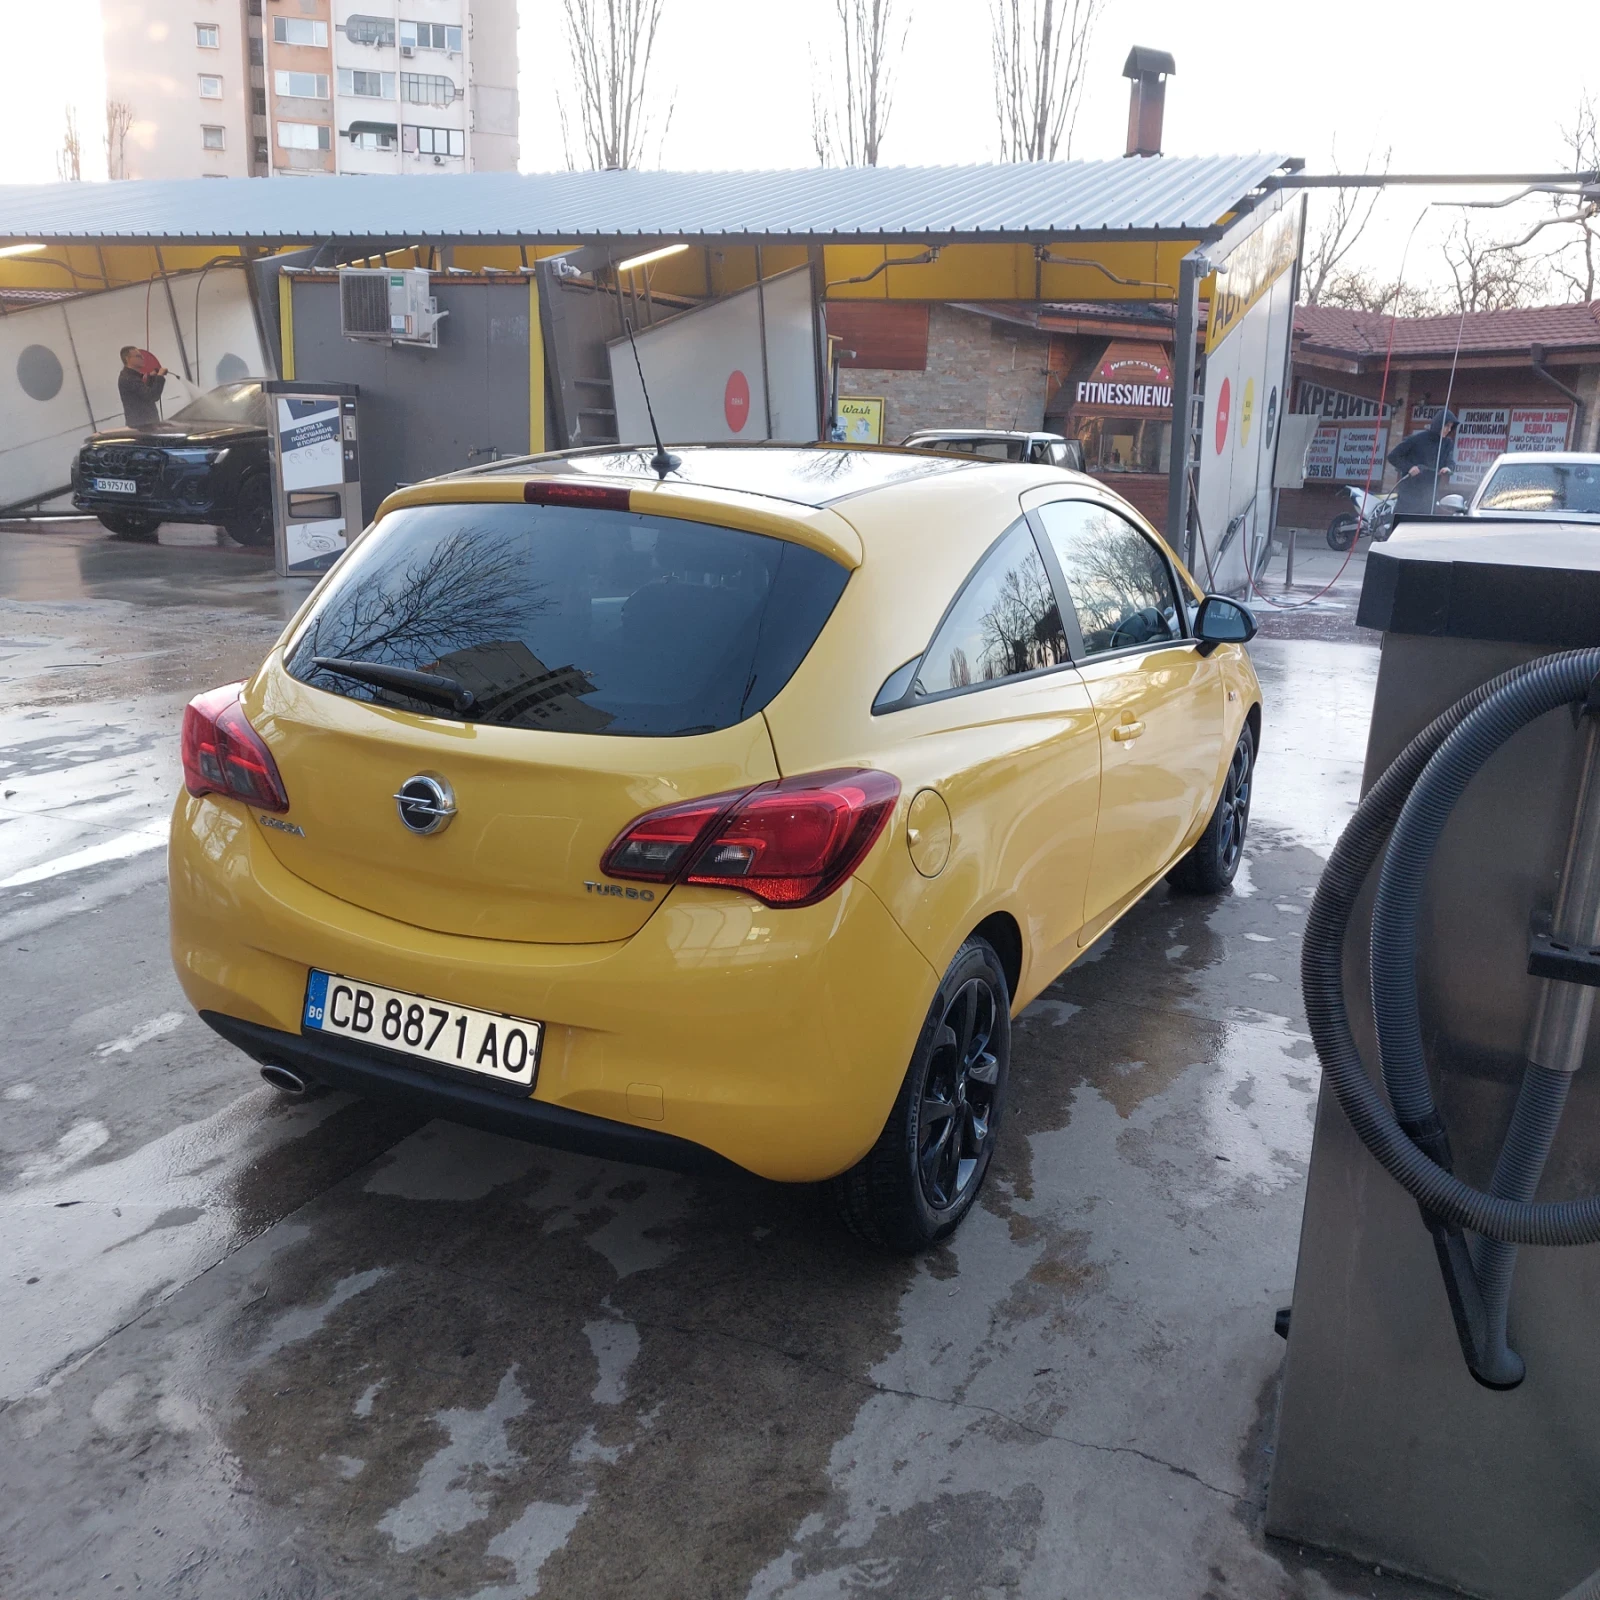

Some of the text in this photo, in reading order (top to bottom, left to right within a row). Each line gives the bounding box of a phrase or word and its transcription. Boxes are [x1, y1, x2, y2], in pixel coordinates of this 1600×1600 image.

[1077, 381, 1173, 407] FITNESSMENU.
[1299, 382, 1388, 419] КРЕДИТИ
[842, 404, 871, 415] Wash
[1413, 407, 1441, 420] КРЕДИ
[1465, 411, 1505, 423] ЛИЗИНГ НА
[295, 422, 324, 434] КЪРПИ ЗА
[1458, 423, 1508, 435] АВТОМОБИЛИ
[1457, 437, 1505, 450] ИПОТЕЧНИ
[1515, 443, 1532, 451] КАРТА
[107, 481, 123, 490] 9757
[124, 482, 135, 491] KO
[583, 880, 655, 902] TURBO
[308, 1005, 323, 1020] BG
[330, 985, 528, 1073] CB 8871 AO
